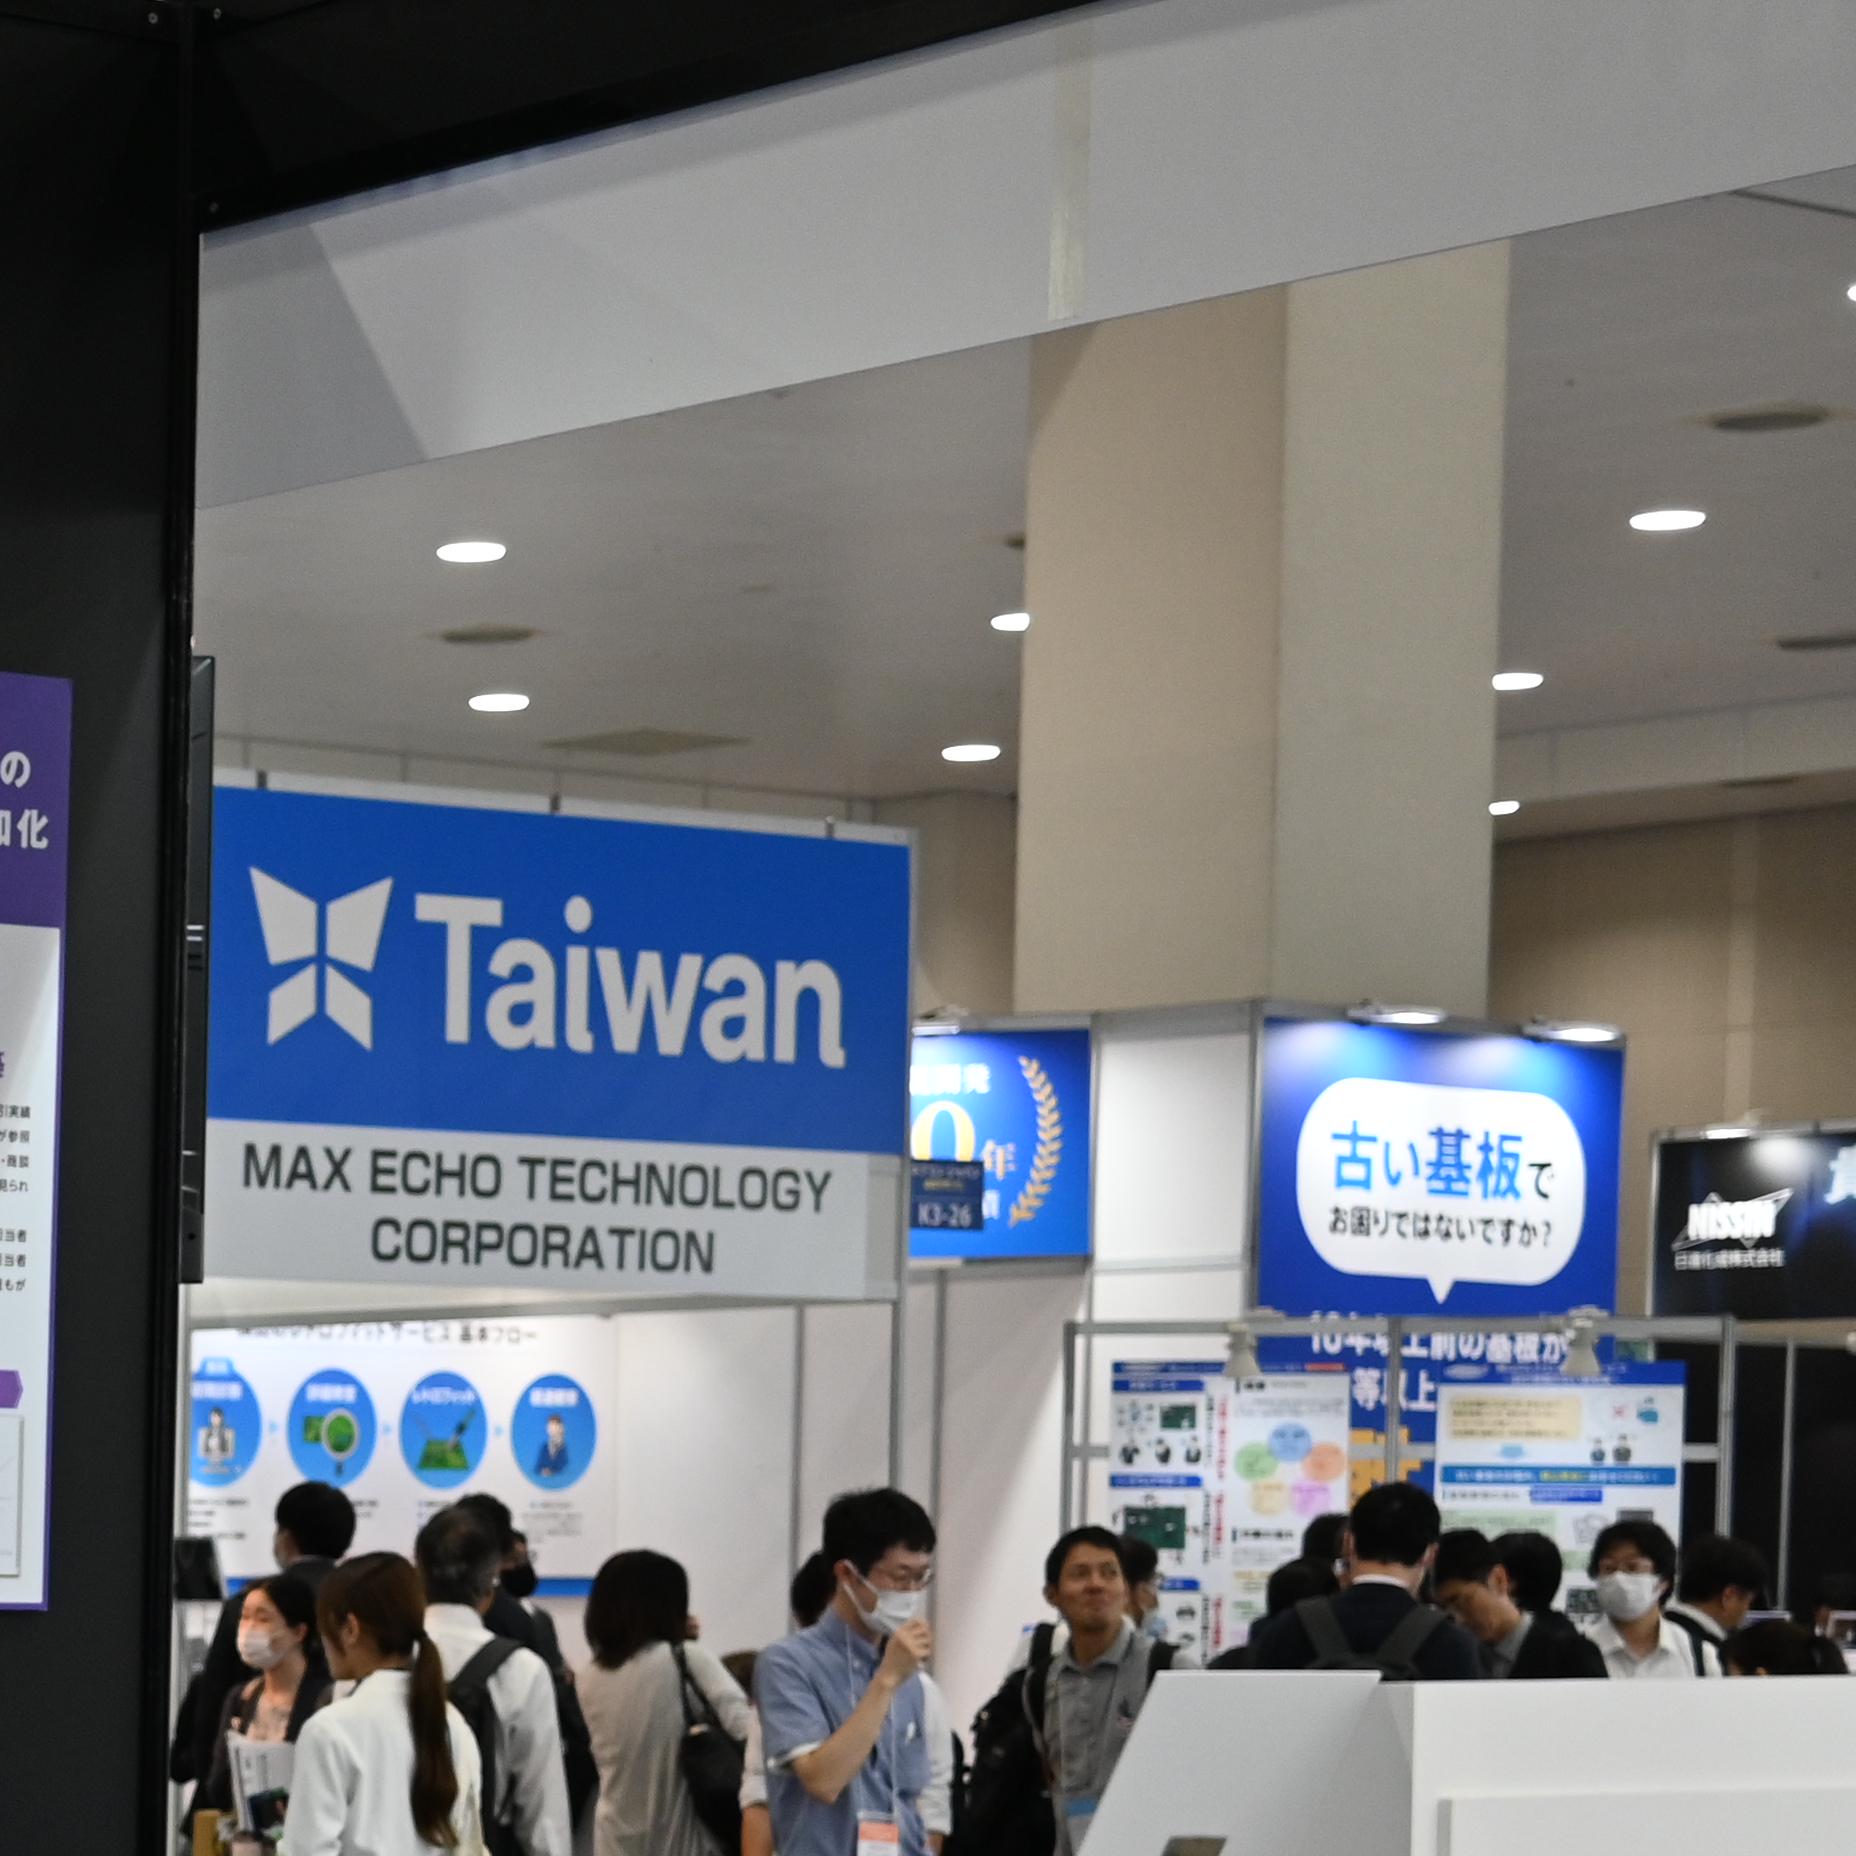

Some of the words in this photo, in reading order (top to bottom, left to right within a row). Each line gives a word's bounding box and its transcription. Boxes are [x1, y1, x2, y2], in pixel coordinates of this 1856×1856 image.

[415, 892, 846, 1069] Taiwan
[242, 1142, 354, 1194] MAX
[369, 1149, 503, 1202] ECHO
[519, 1154, 832, 1214] TECHNOLOGY
[1331, 1120, 1556, 1201] 古い基板で
[370, 1216, 716, 1275] CORPORATION
[1329, 1206, 1552, 1248] お困りではないですか?
